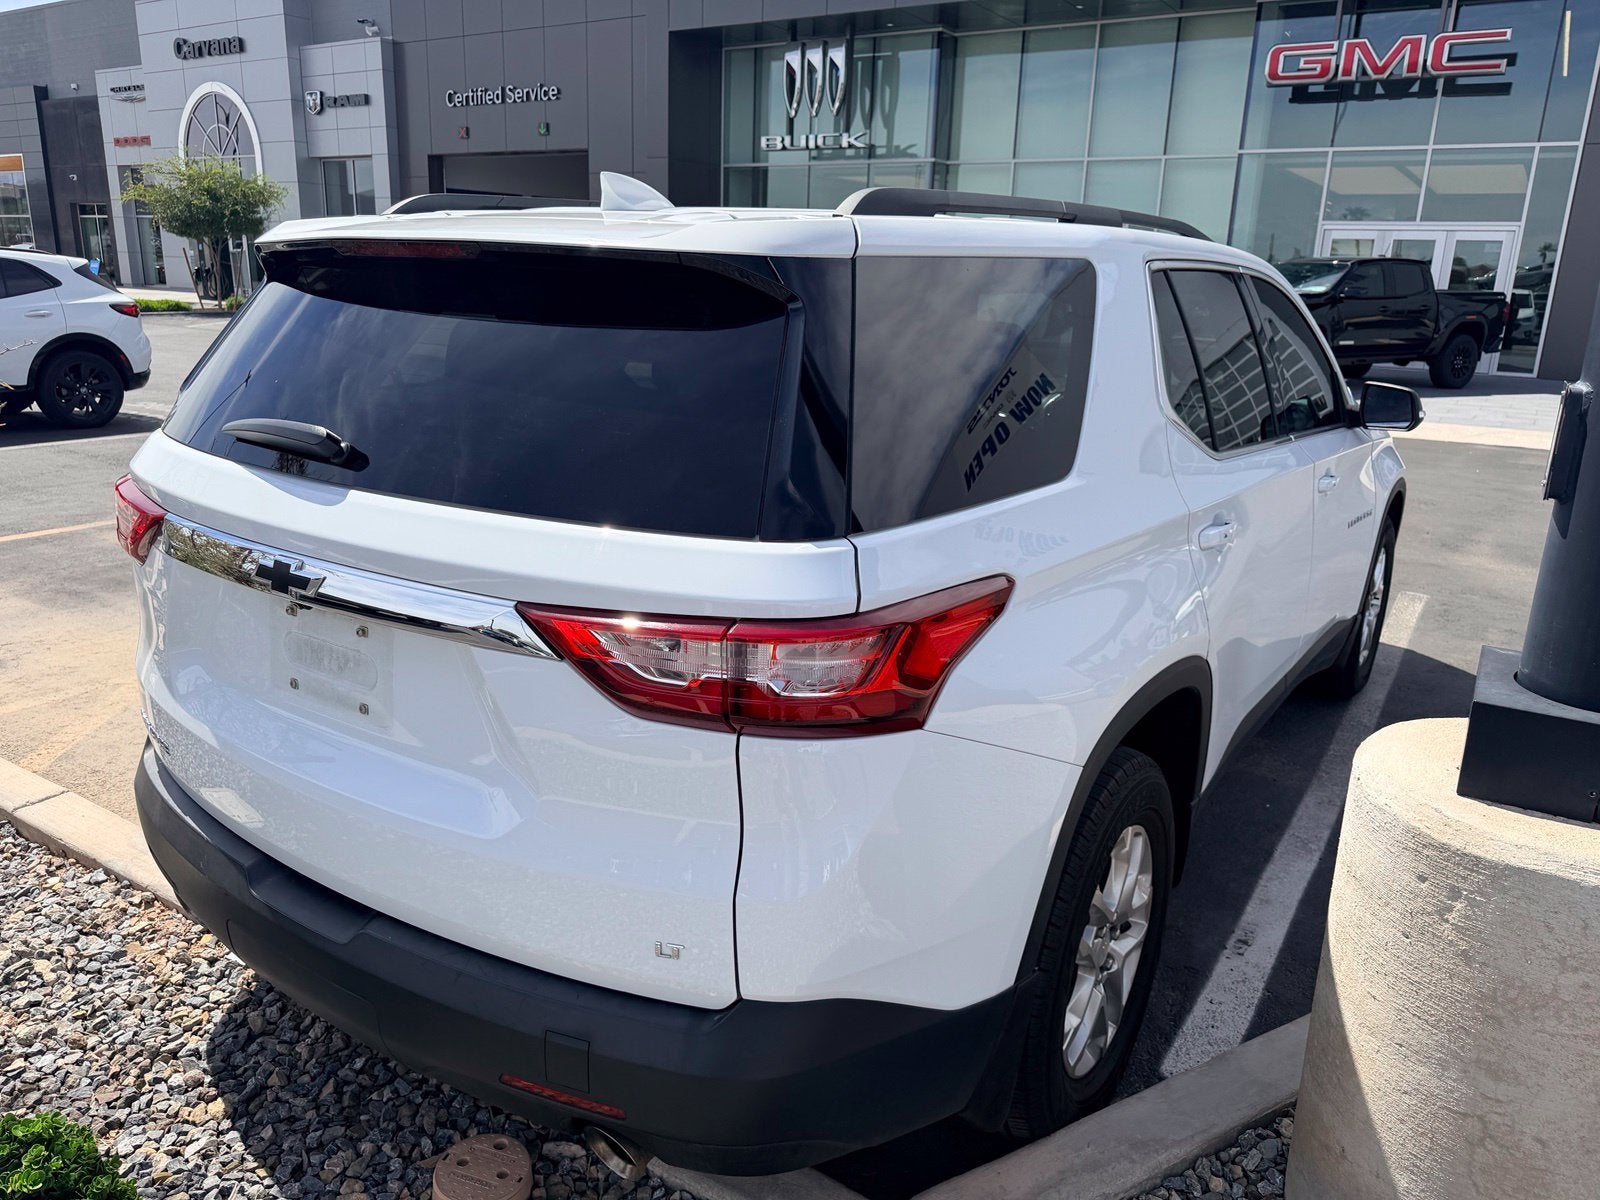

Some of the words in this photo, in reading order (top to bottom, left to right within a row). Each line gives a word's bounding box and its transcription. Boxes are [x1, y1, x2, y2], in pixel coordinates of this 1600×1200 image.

[173, 36, 242, 59] Carvana
[1265, 28, 1512, 85] GMC
[324, 94, 367, 108] RAM
[445, 86, 502, 107] Certified
[505, 83, 559, 103] Service
[760, 132, 868, 151] BUICK
[655, 941, 685, 960] LT
